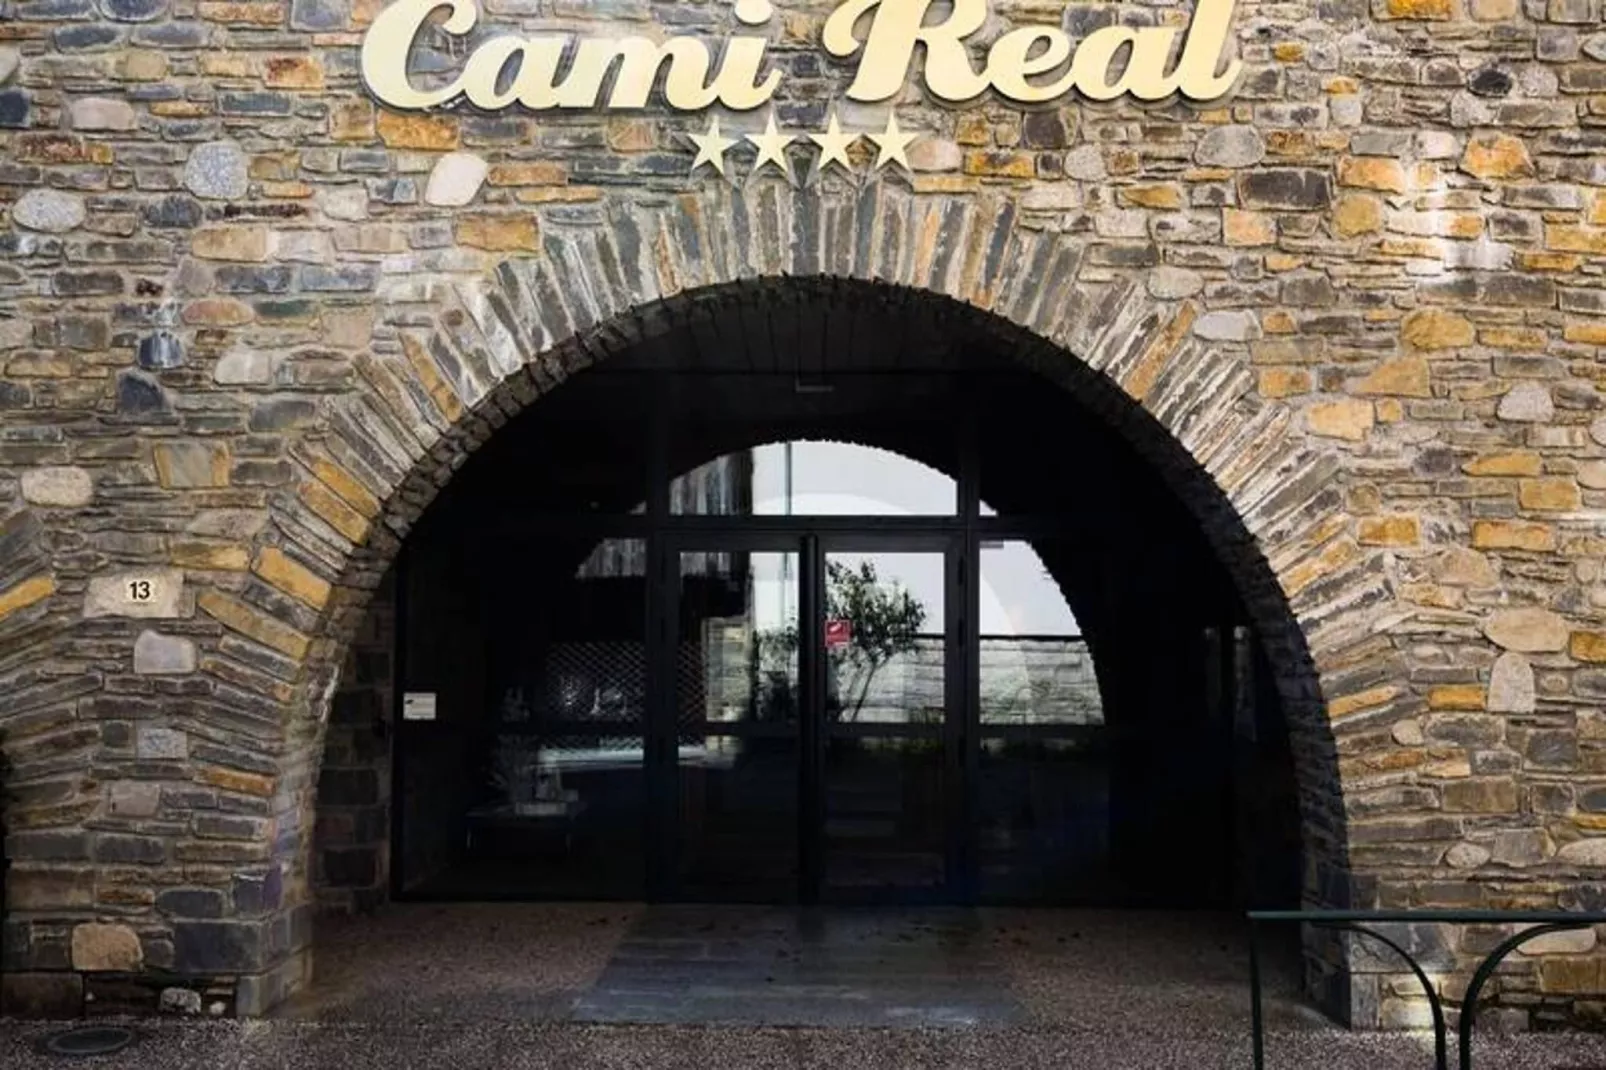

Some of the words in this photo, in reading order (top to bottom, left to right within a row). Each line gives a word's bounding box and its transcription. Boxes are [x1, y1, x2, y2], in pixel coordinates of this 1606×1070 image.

[361, 0, 782, 110] Cami
[822, 0, 1243, 102] Real
[129, 580, 151, 600] 13
